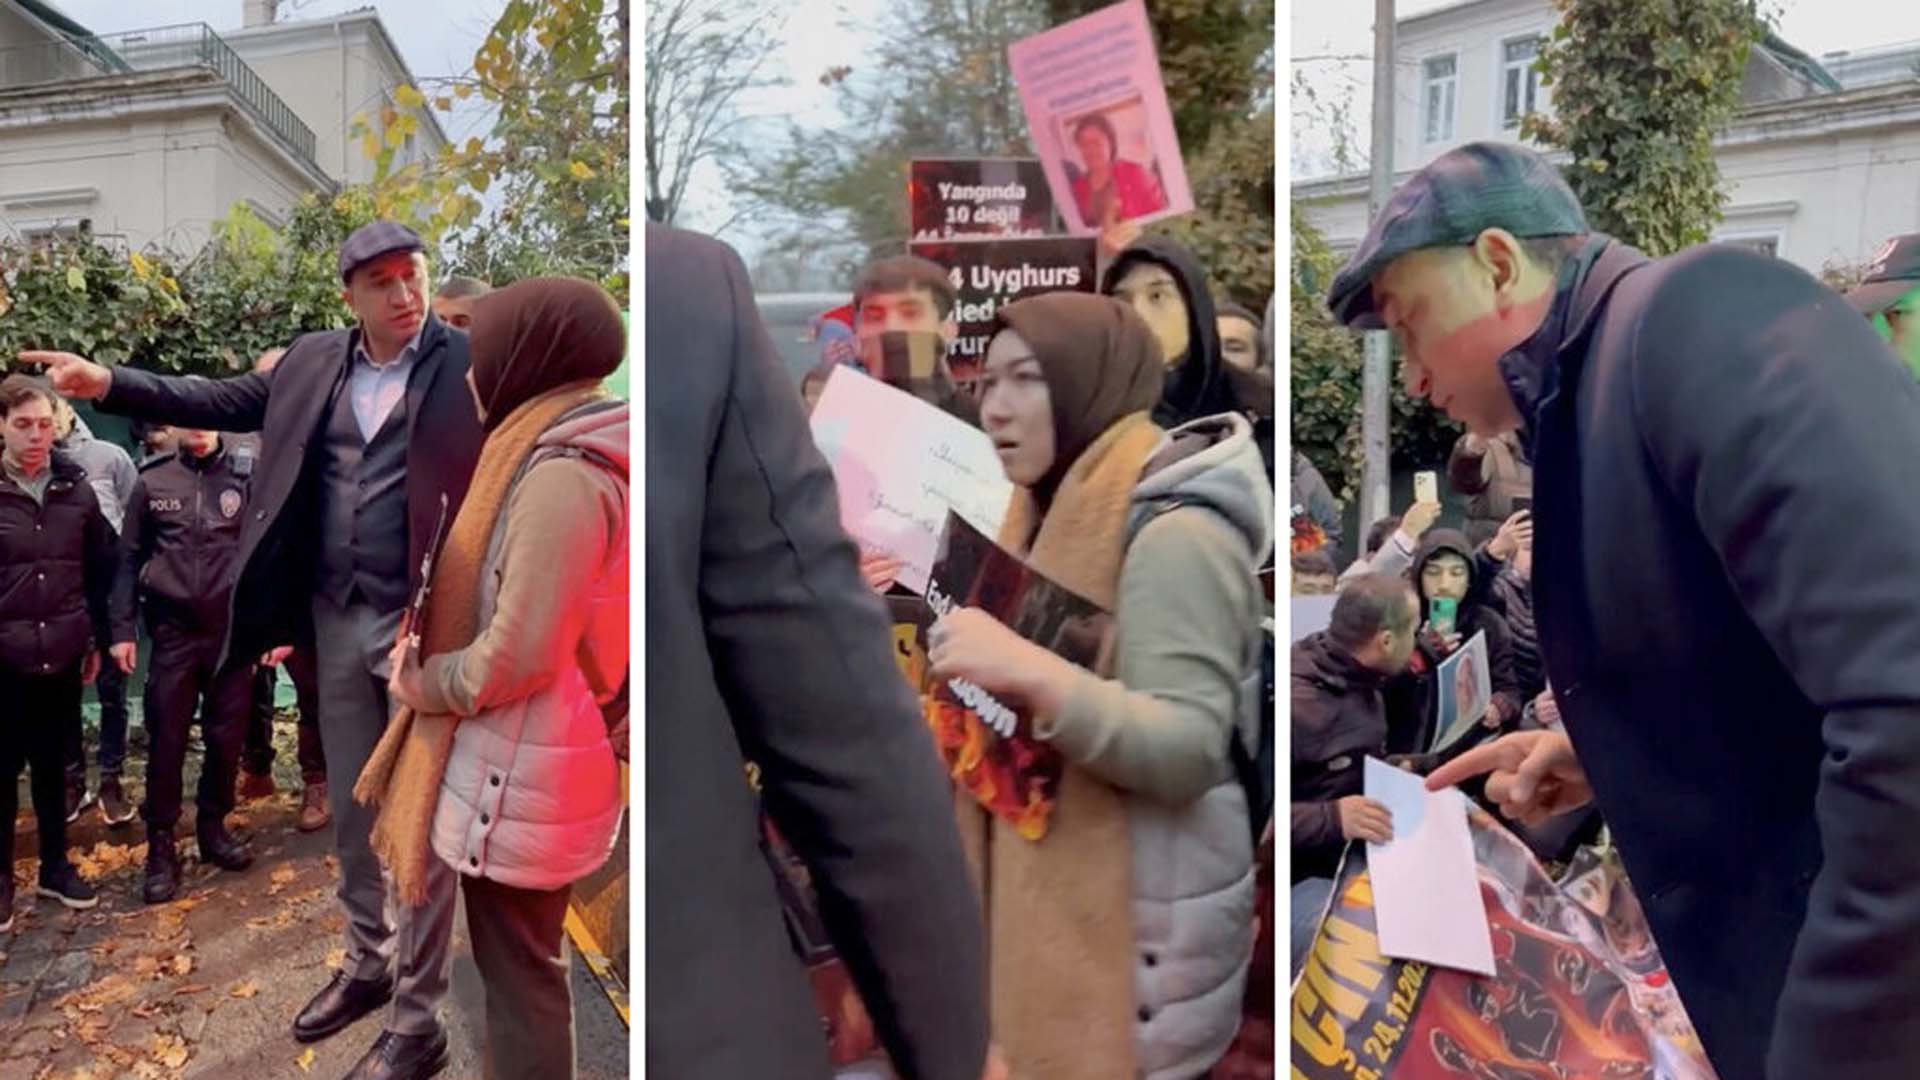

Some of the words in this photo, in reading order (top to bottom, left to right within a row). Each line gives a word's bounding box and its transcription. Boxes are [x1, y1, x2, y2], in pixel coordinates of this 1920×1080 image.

[945, 205, 970, 224] 10
[948, 266, 964, 290] 4
[971, 263, 1081, 294] Uyghurs
[954, 298, 995, 322] ied
